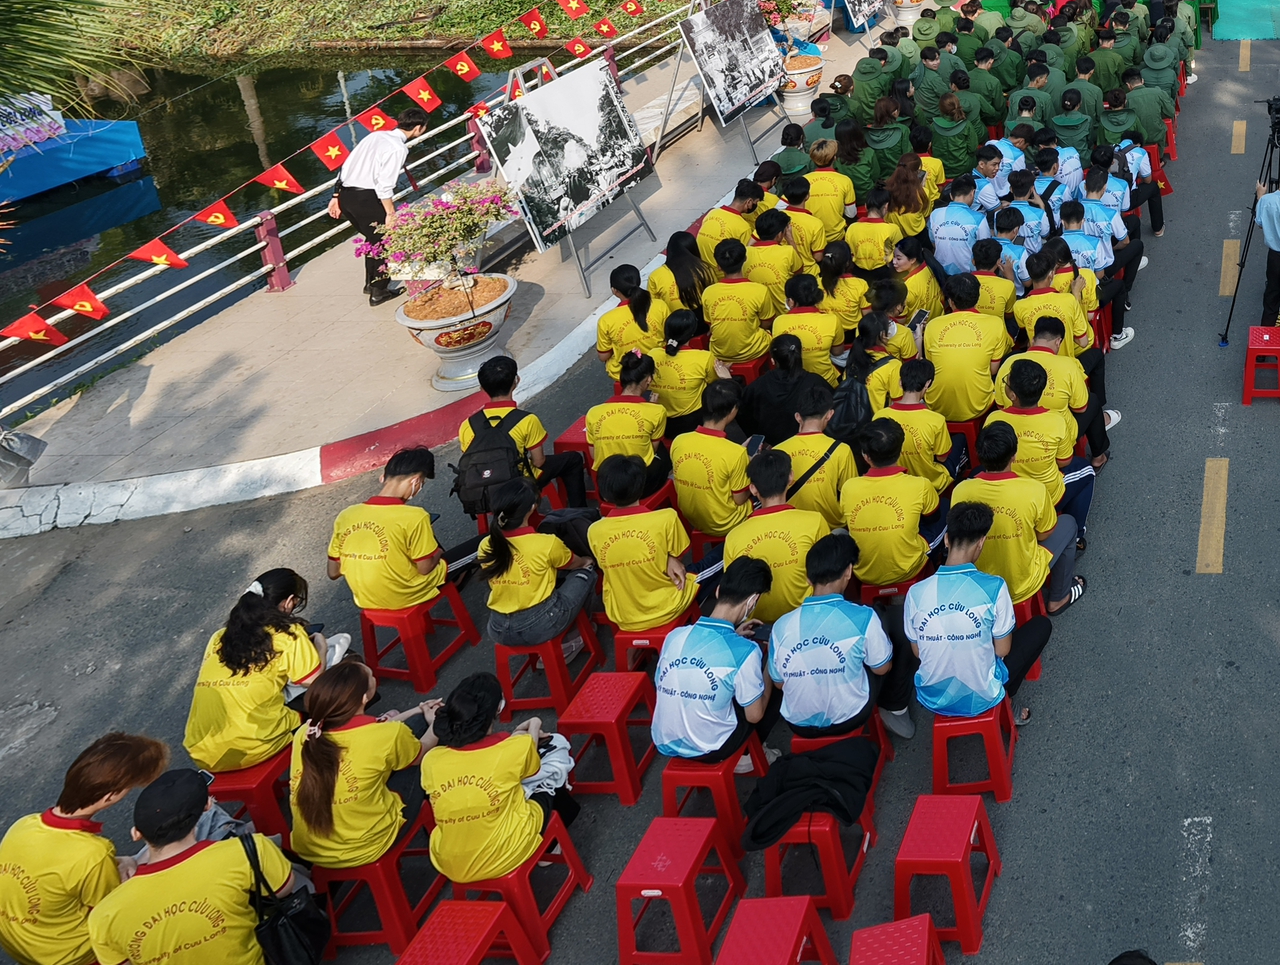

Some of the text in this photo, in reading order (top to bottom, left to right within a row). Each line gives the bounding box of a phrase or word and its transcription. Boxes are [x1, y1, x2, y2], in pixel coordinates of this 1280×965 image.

[919, 601, 982, 632] ĐẠI HỌC CỬU LONG
[782, 635, 847, 669] ĐẠI HỌC CỬU LONG
[660, 656, 719, 692] ĐẠI HỌC CỬU LONG
